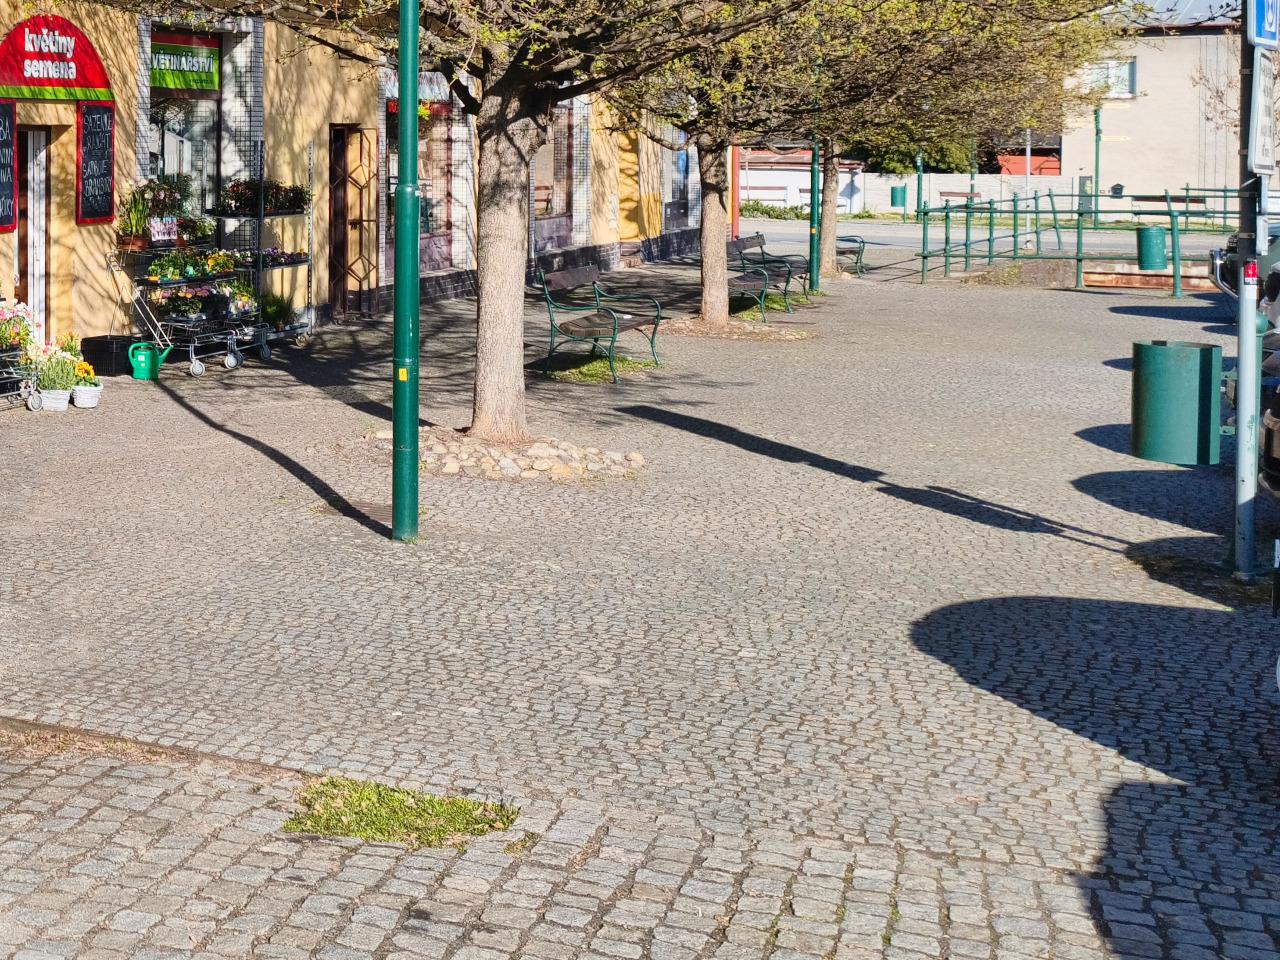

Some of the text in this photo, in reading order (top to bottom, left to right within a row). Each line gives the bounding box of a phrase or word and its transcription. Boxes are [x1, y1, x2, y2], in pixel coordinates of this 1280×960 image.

[24, 27, 76, 59] květiny
[23, 58, 77, 80] semena
[151, 48, 214, 73] VĚTINÁŘSTVÍ
